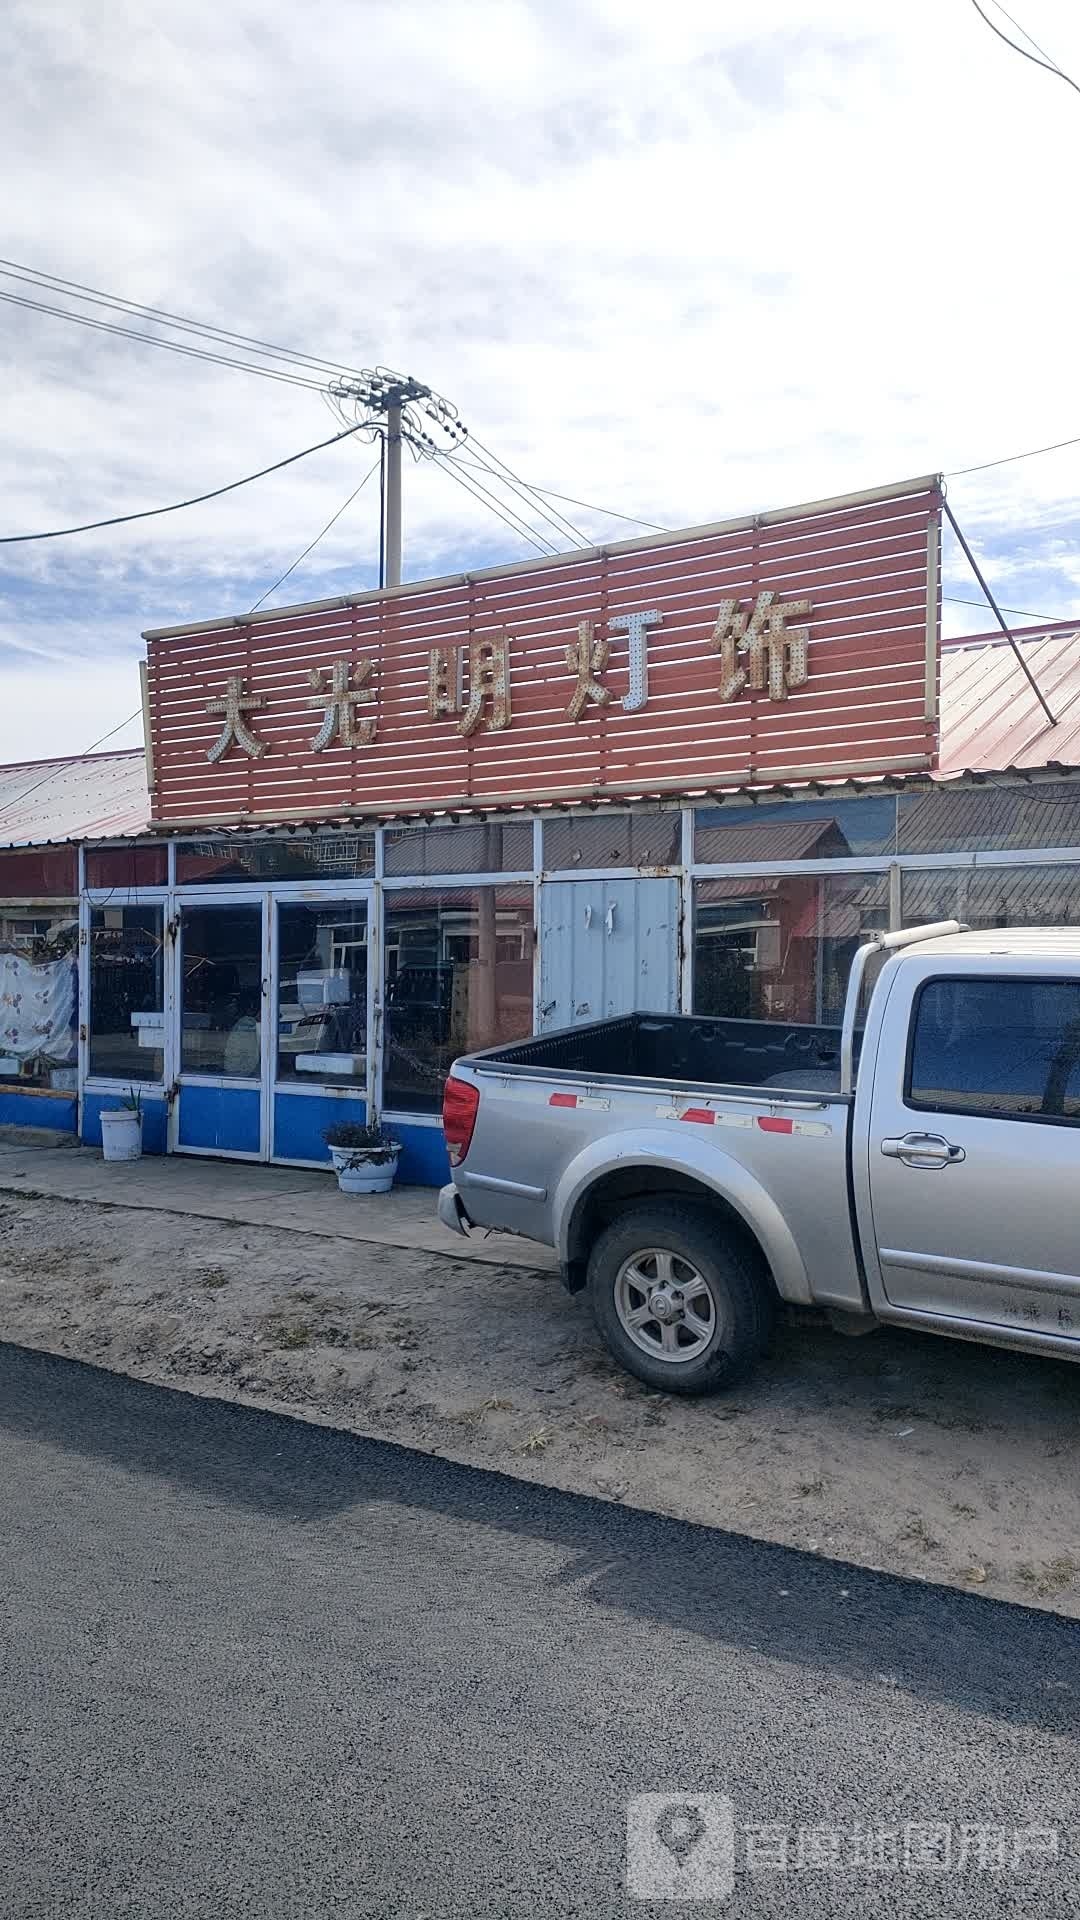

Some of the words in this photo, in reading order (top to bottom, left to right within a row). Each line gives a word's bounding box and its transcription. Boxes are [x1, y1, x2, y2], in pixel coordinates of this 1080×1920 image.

[204, 591, 812, 763] 大光明灯饰
